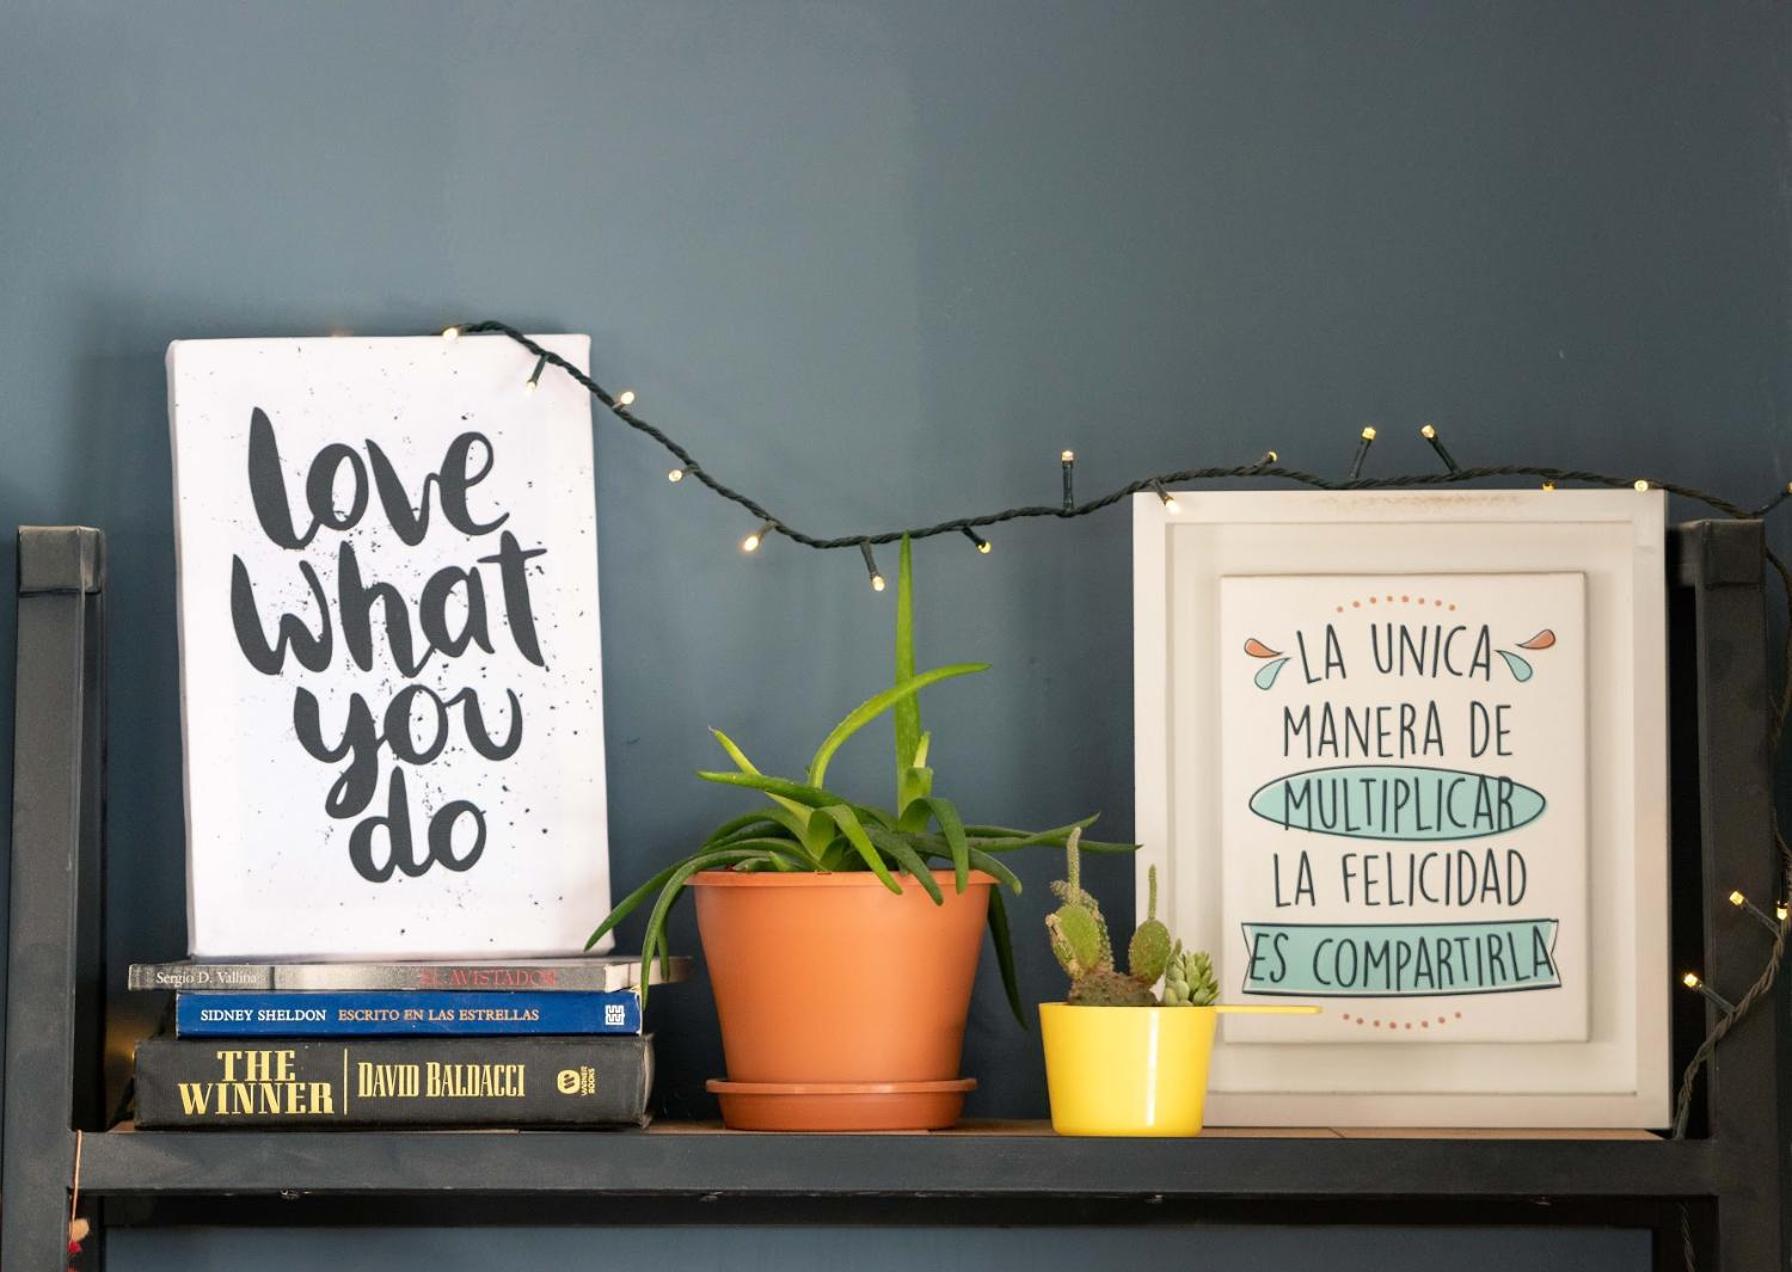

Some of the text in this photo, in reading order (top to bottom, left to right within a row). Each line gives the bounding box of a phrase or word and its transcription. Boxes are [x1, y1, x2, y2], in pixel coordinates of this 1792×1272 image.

[248, 406, 510, 549] love
[230, 530, 548, 679] what
[1296, 622, 1493, 684] LA UNICA
[293, 684, 523, 820] you
[1283, 701, 1514, 759] MANERA DE
[349, 765, 487, 884] do
[1283, 775, 1516, 833] MULTIPLICAR
[1272, 848, 1528, 908] LA FELICIDAD
[156, 971, 195, 987] Sergio
[198, 971, 213, 984] D.
[1249, 924, 1556, 991] ES COMPARTIRLA
[200, 1009, 327, 1021] SIDNEY SHELDON
[338, 1009, 540, 1021] ESCRITO EN LAS ESTRELLAS
[216, 1050, 296, 1082] THE
[357, 1062, 526, 1097] DAVID BALDACCI
[177, 1082, 335, 1115] WINNER
